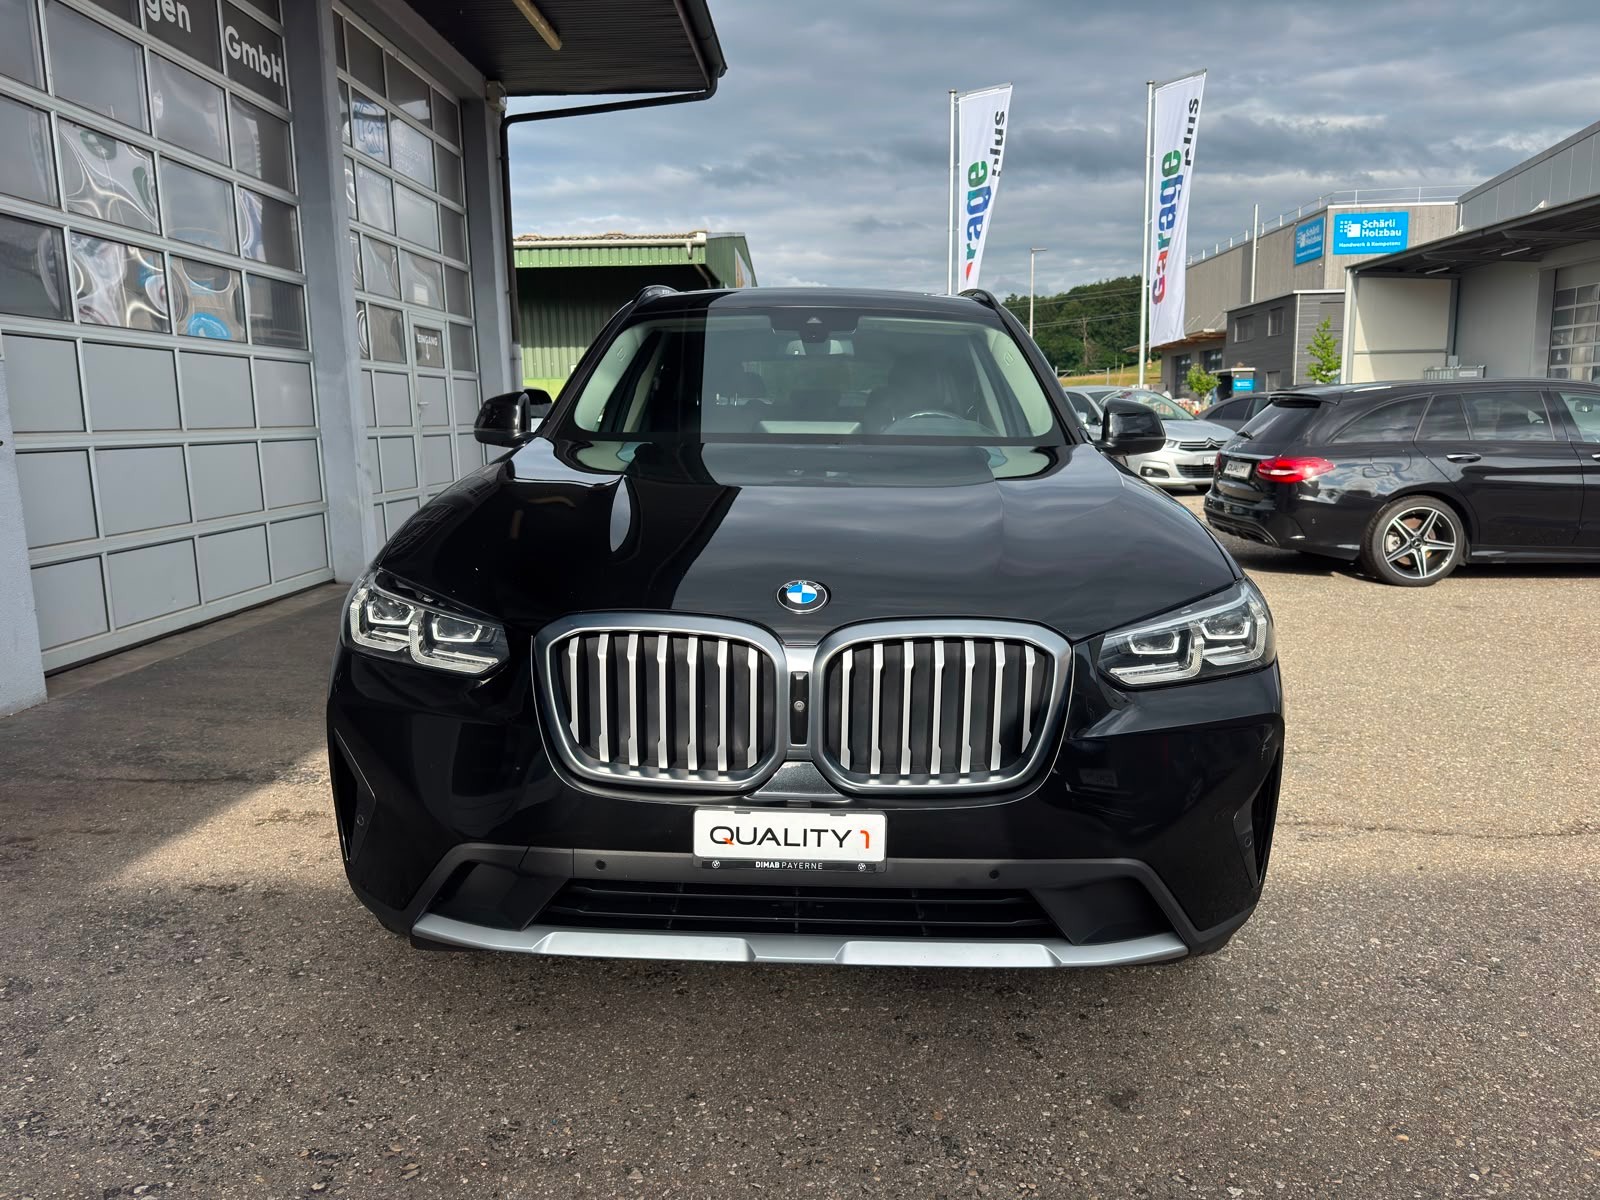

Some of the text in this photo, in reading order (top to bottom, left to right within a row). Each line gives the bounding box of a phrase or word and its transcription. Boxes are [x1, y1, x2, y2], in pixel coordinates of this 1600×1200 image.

[225, 25, 284, 87] GmbH
[1362, 219, 1396, 229] Schärli
[1361, 228, 1402, 238] Holzbau
[709, 826, 870, 849] QUALITY 1
[755, 861, 823, 870] DIMAB PAYERNE
